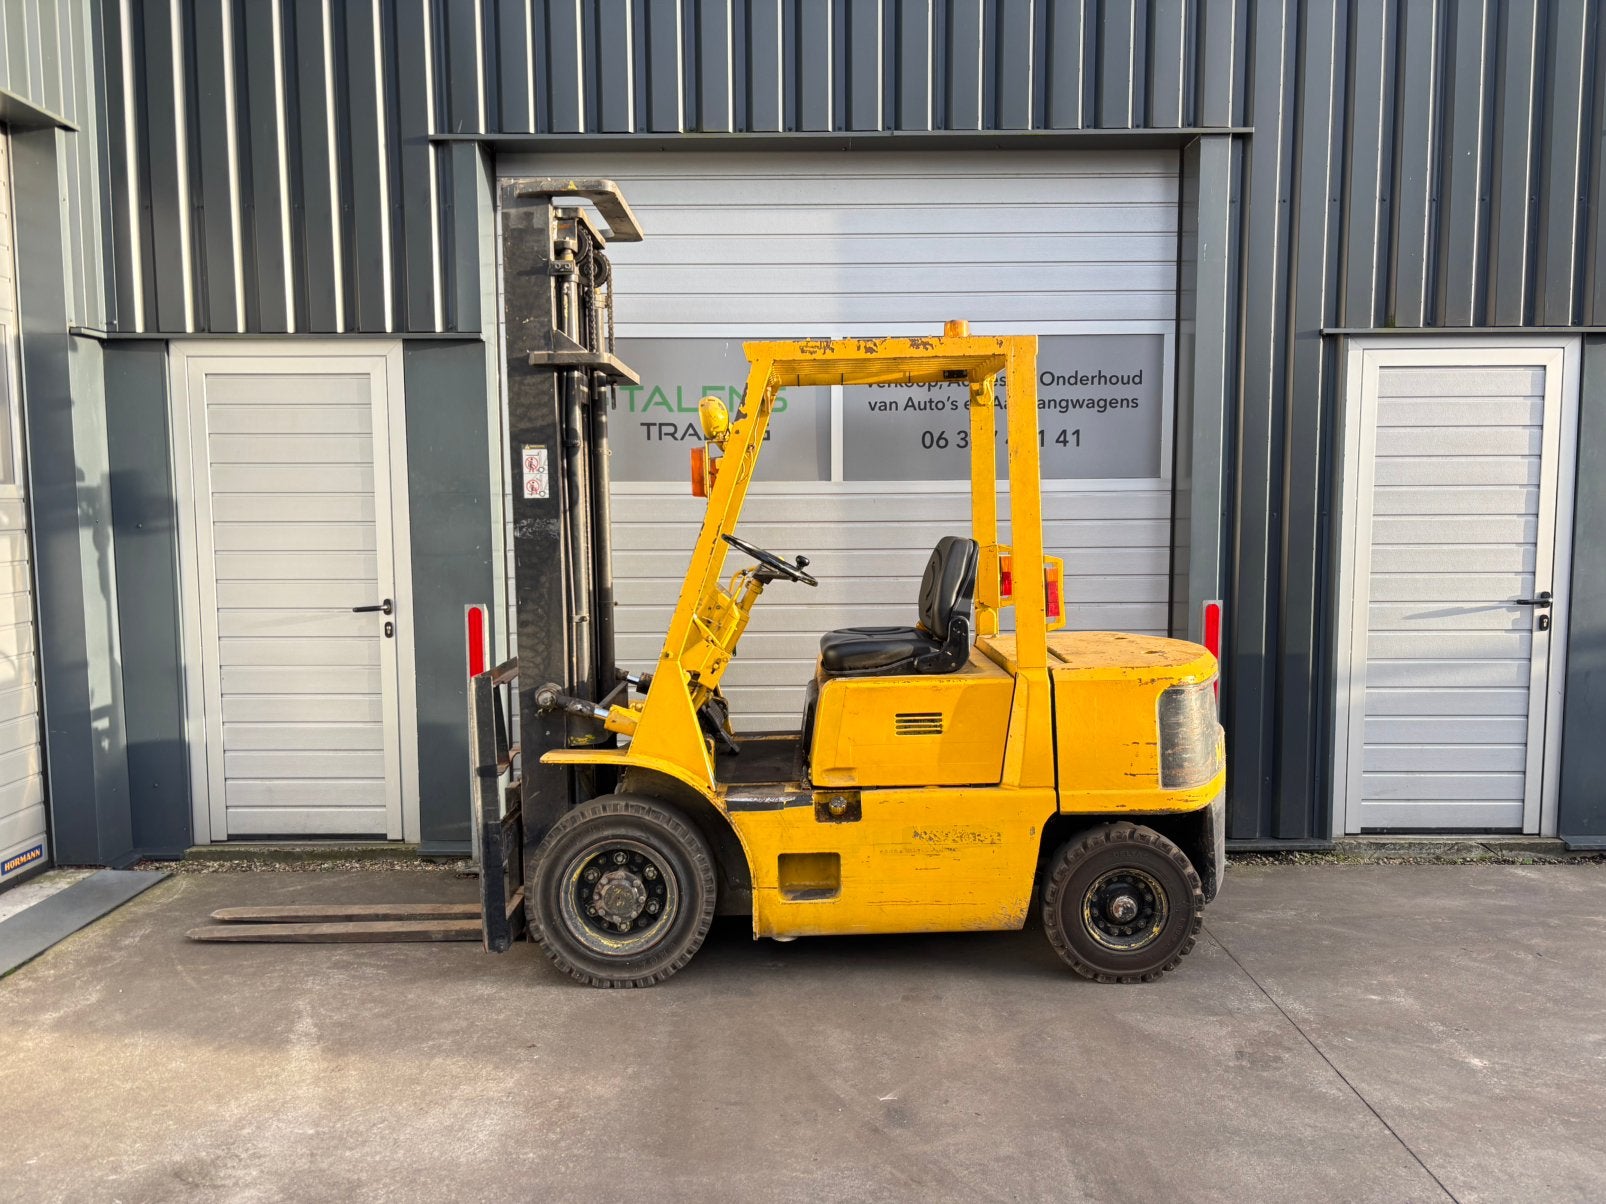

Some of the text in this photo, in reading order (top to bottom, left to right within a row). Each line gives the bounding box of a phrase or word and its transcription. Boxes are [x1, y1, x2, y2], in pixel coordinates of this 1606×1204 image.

[1040, 369, 1143, 387] Onderhoud
[868, 400, 899, 411] van
[921, 430, 949, 449] 06
[1055, 429, 1081, 448] 41
